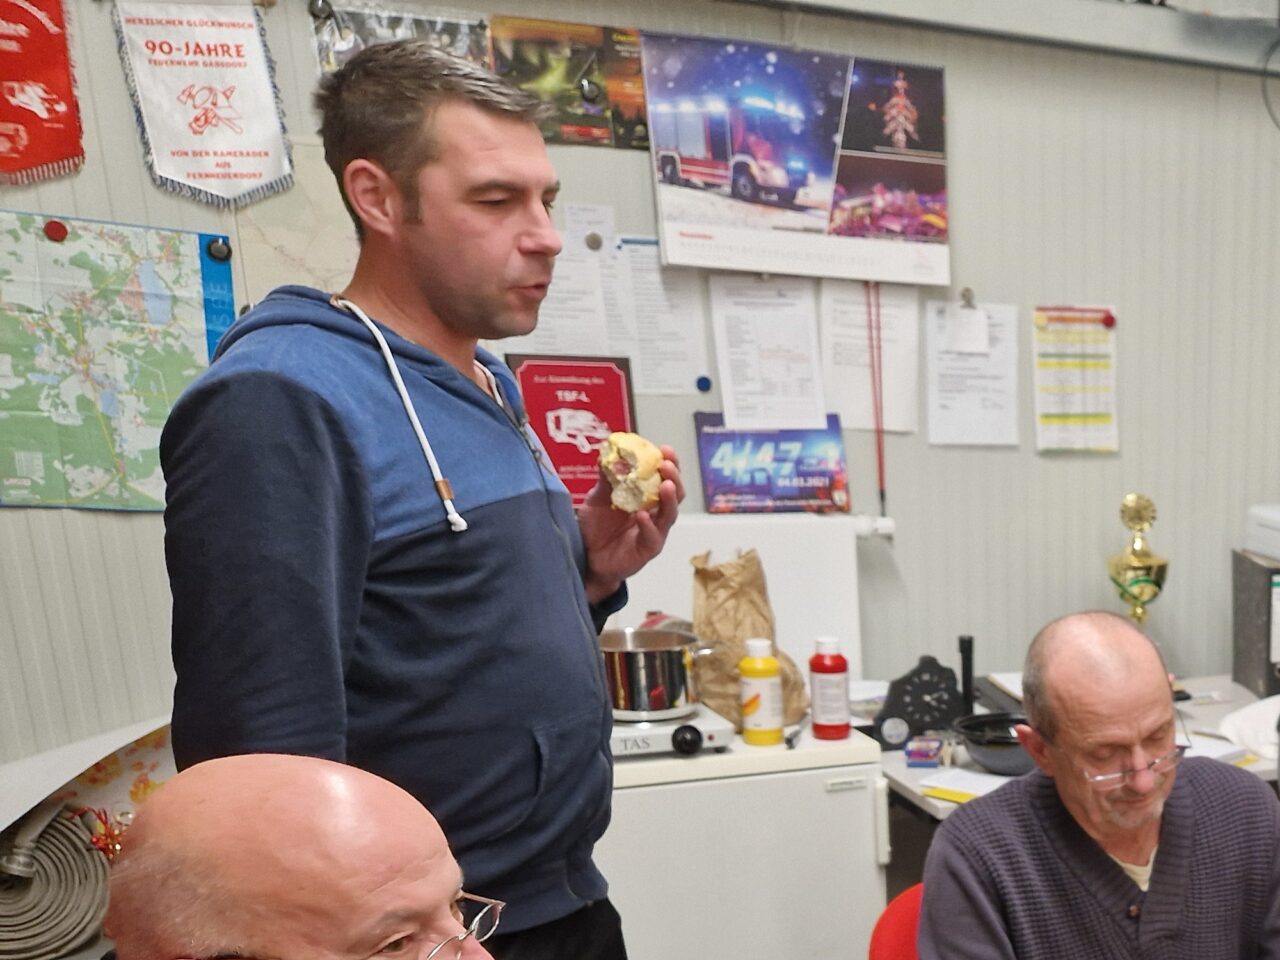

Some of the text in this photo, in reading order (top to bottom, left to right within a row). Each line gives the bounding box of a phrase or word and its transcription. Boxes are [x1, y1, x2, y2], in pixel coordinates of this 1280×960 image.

[144, 40, 246, 58] 90-JAHRE
[171, 150, 270, 158] VON DEN KAMERADEN
